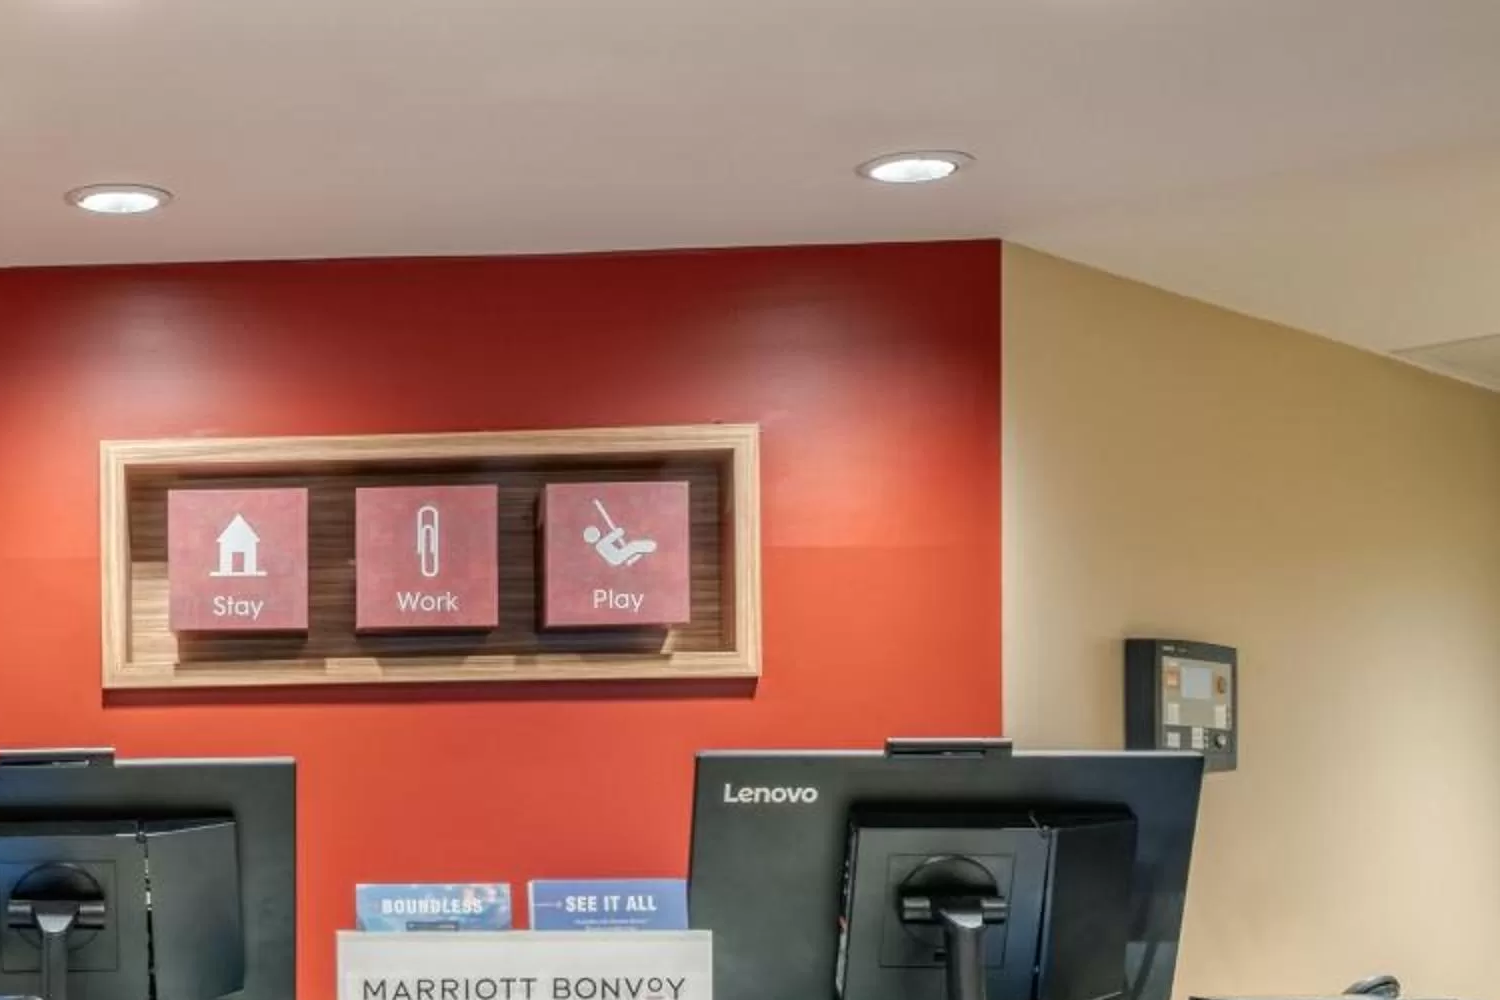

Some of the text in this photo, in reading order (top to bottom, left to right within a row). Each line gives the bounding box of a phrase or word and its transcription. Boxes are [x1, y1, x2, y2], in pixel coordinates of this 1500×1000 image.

[213, 594, 263, 620] Stay
[397, 591, 459, 613] Work
[592, 588, 645, 613] Play
[723, 783, 819, 804] Lenovo
[381, 897, 483, 915] BOUNDLESS
[565, 894, 657, 913] SEE IT ALL
[553, 977, 686, 1000] BONVOY
